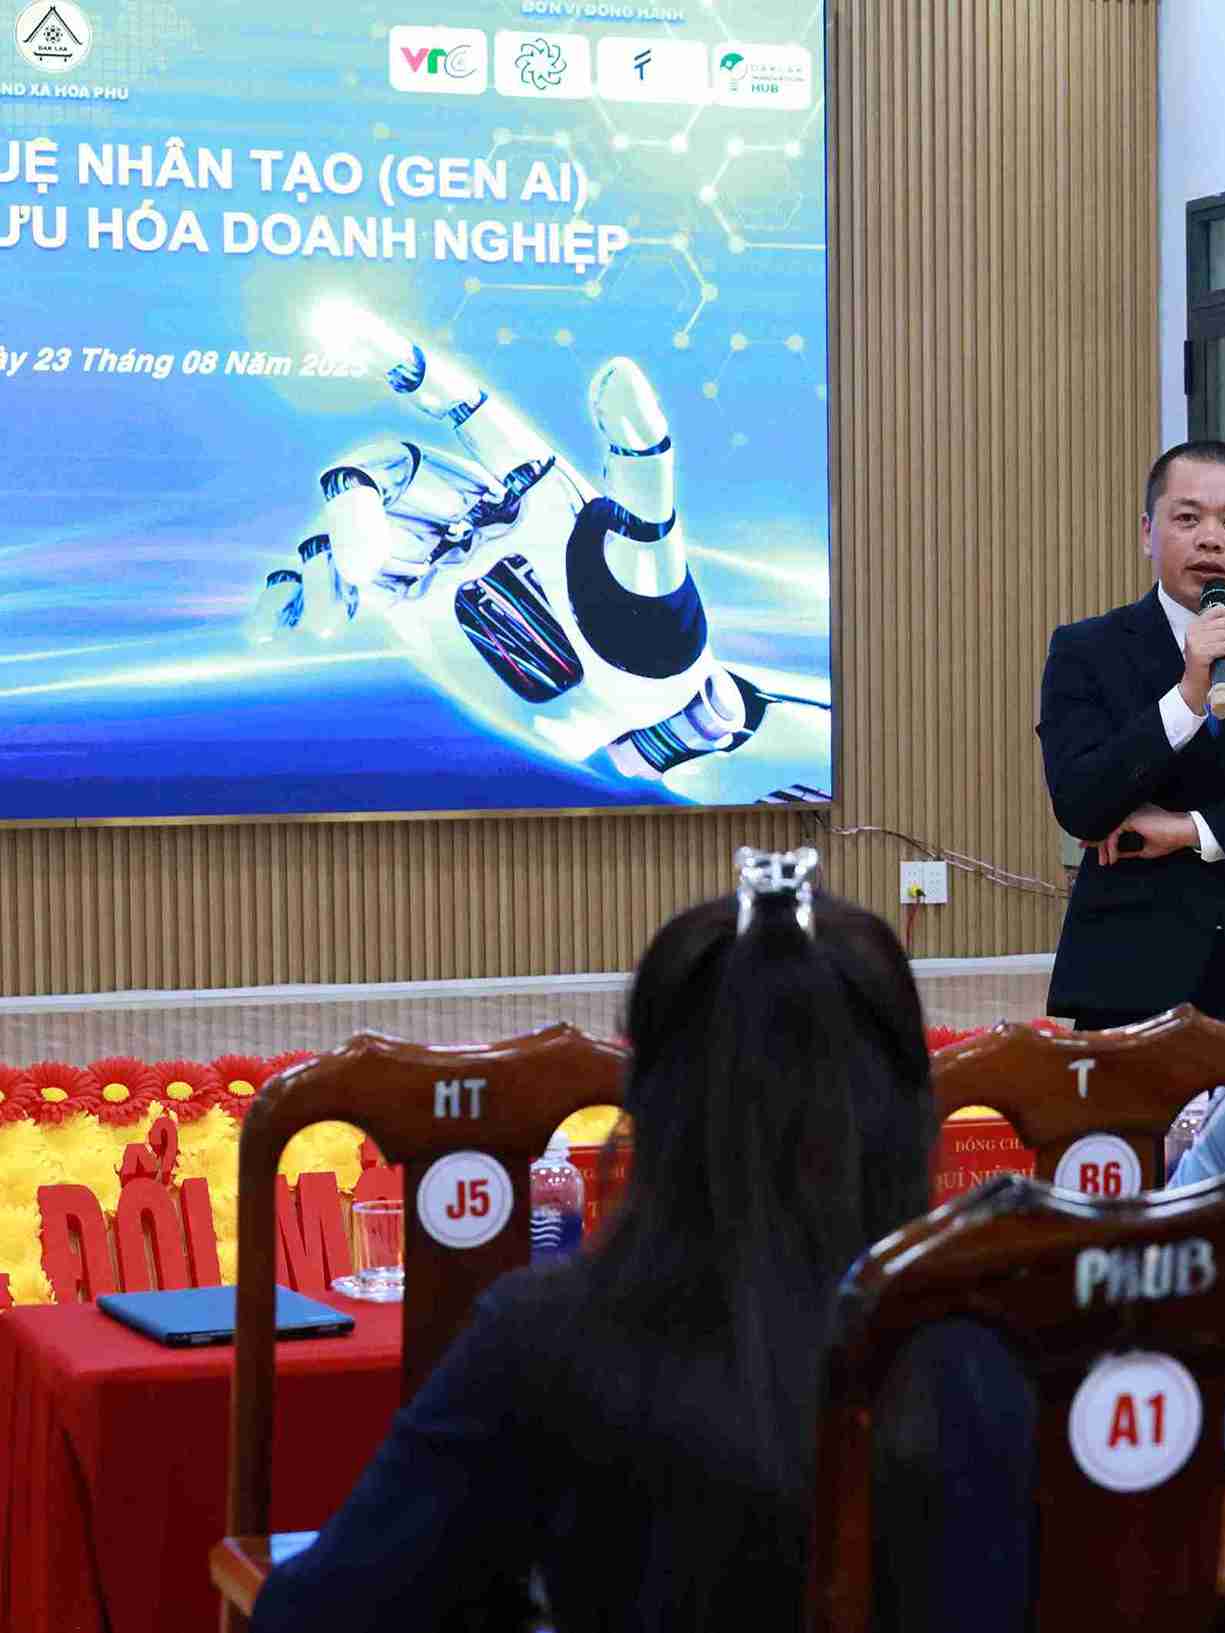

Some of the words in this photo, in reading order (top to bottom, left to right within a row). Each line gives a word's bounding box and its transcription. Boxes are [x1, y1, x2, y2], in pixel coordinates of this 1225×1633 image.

[752, 83, 779, 93] HUB
[78, 136, 233, 190] NHÂN
[249, 149, 363, 204] TẠO
[379, 154, 507, 206] (GEN
[520, 160, 589, 212] AI)
[88, 199, 209, 253] HÓA
[223, 212, 417, 259] DOANH
[433, 216, 630, 274] NGHIỆP
[33, 347, 72, 373] 23
[81, 347, 175, 379] Tháng
[181, 350, 217, 375] 08
[224, 350, 293, 377] Năm
[999, 1137, 1024, 1152] CH
[446, 1179, 491, 1220] J5
[1107, 1392, 1167, 1449] A1
